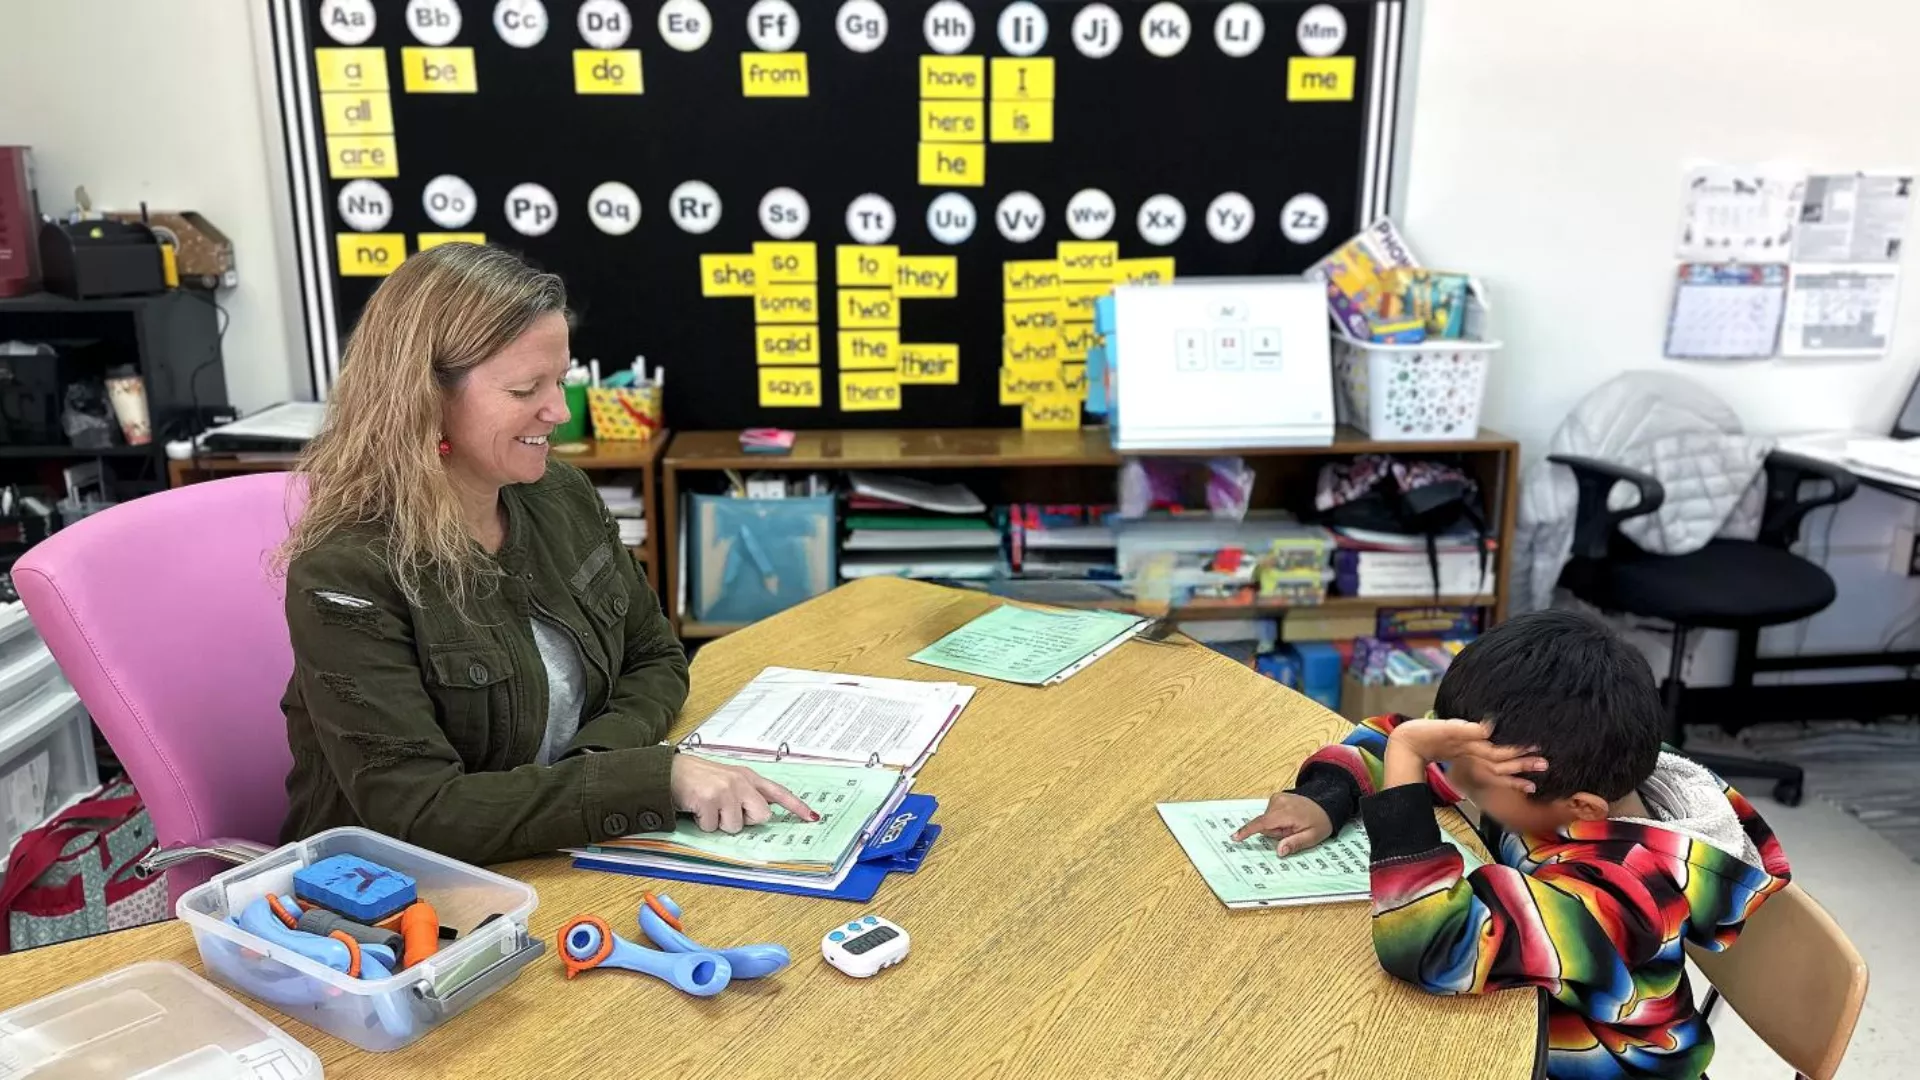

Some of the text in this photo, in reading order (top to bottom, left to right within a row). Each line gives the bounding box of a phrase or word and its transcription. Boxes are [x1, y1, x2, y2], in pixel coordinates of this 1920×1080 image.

[332, 7, 365, 26] Aa
[416, 8, 449, 26] Bb
[503, 10, 537, 29] Cc
[587, 12, 620, 31] Dd
[668, 14, 699, 32] Ee
[758, 15, 786, 36] Ff
[845, 15, 878, 38] Gg
[934, 18, 965, 36] Hh
[1014, 17, 1032, 43] Ii
[1083, 20, 1107, 46] Jj
[1150, 20, 1180, 37] Kk
[1225, 19, 1249, 41] Ll
[1303, 24, 1338, 37] Mm
[345, 64, 362, 78] a
[423, 59, 455, 80] be
[592, 59, 623, 80] do
[750, 64, 800, 82] from
[928, 68, 976, 87] have
[1018, 67, 1030, 92] I
[1302, 73, 1337, 88] me
[345, 100, 371, 121] all
[929, 113, 974, 131] here
[1011, 112, 1030, 132] is
[340, 148, 385, 165] are
[938, 152, 966, 174] he
[348, 196, 382, 214] Nn
[431, 194, 465, 212] Oo
[513, 199, 551, 221] Pp
[596, 200, 629, 220] Qq
[680, 198, 711, 218] Rr
[768, 204, 798, 222] Ss
[859, 212, 882, 229] Tt
[936, 211, 967, 228] Uu
[1004, 211, 1038, 228] Vv
[1073, 209, 1108, 222] Ww
[1147, 212, 1174, 227] Xx
[1217, 209, 1244, 230] Yy
[1292, 211, 1318, 228] Zz
[357, 248, 388, 262] no
[772, 256, 798, 270] so
[1064, 252, 1113, 268] word
[859, 255, 878, 274] to
[714, 264, 755, 285] she
[898, 267, 948, 289] they
[1010, 272, 1061, 288] when
[760, 298, 811, 312] some
[849, 298, 890, 318] two
[1013, 312, 1057, 328] was
[764, 334, 811, 353] said
[852, 340, 887, 357] the
[1011, 343, 1056, 360] what
[902, 353, 952, 375] their
[768, 381, 813, 396] says
[846, 384, 895, 400] there
[1007, 380, 1054, 393] where
